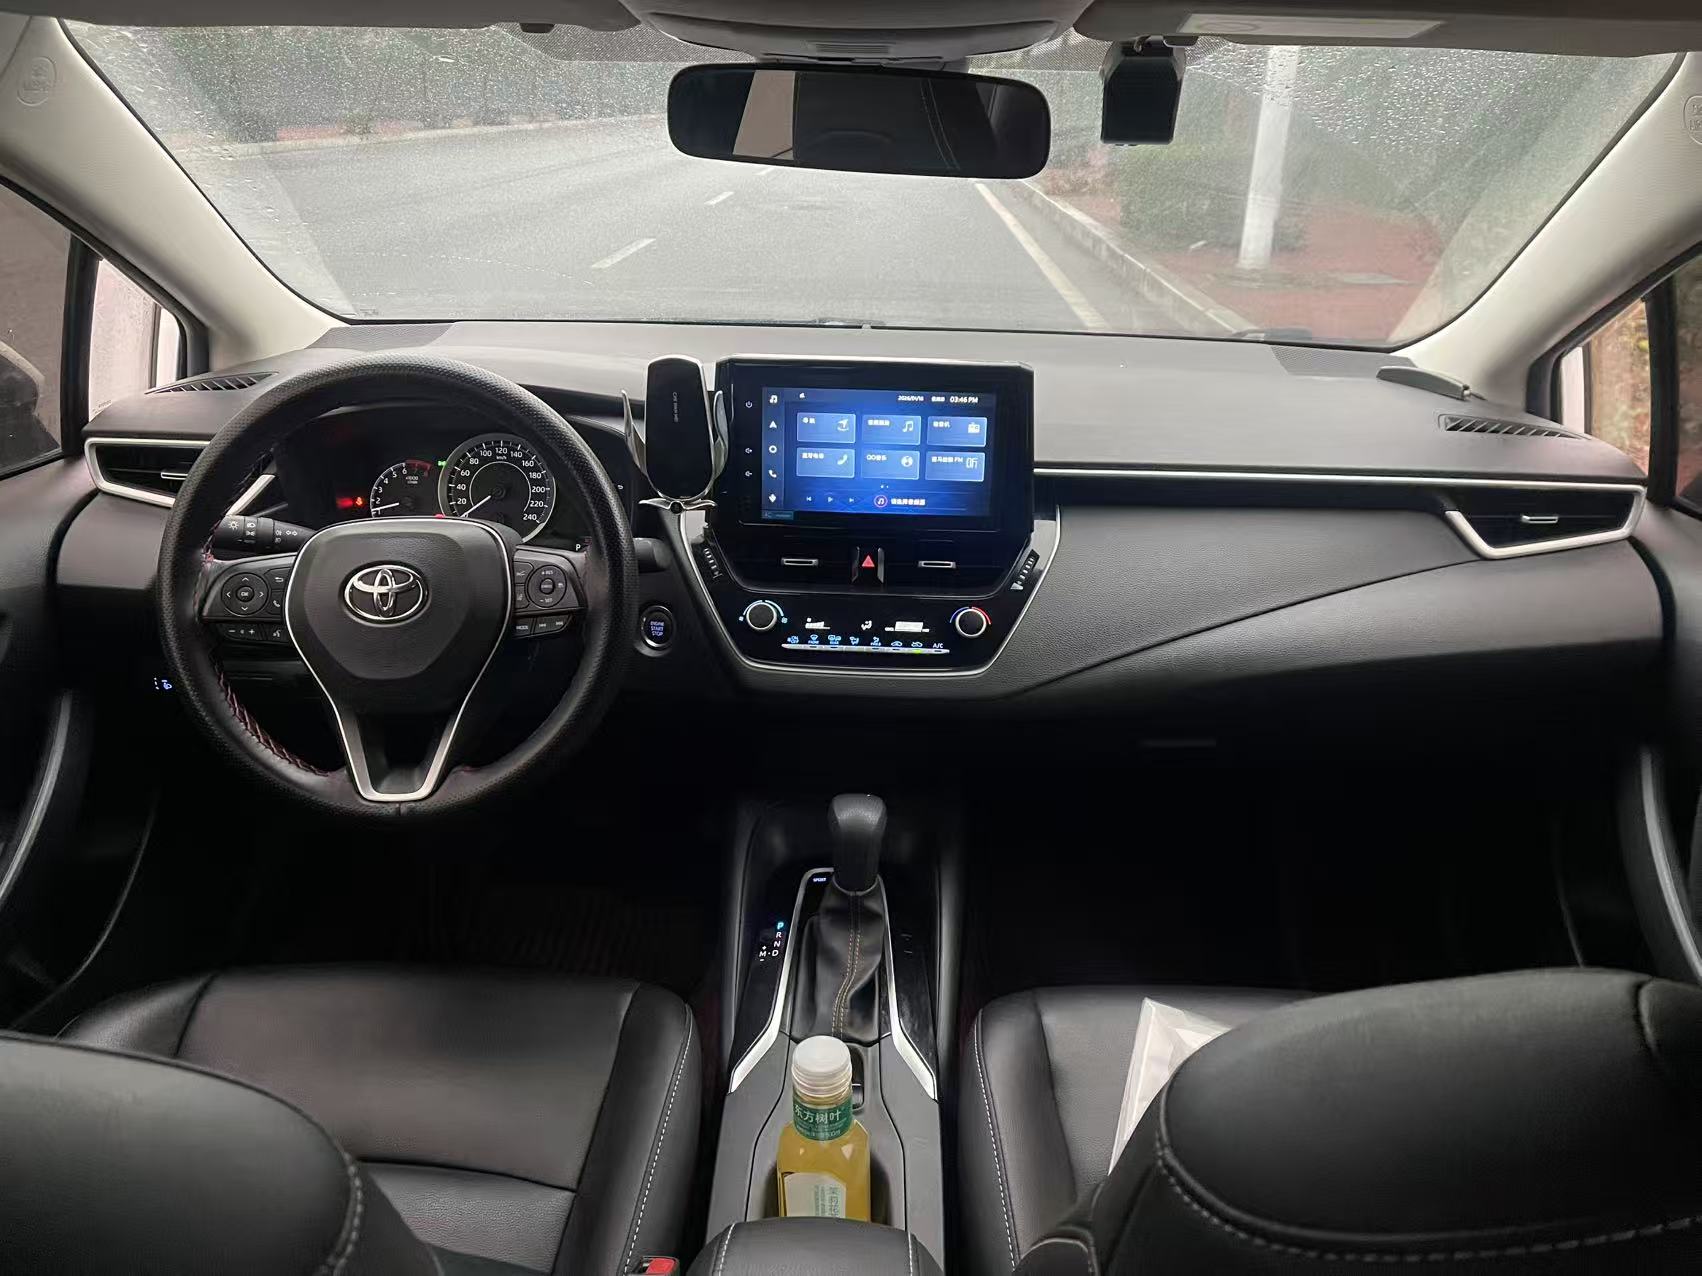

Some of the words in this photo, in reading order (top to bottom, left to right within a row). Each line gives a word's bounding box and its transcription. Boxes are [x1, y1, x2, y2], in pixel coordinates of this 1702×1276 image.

[460, 469, 470, 477] 60
[522, 513, 537, 521] 240
[795, 1104, 841, 1124] 东方树叶
